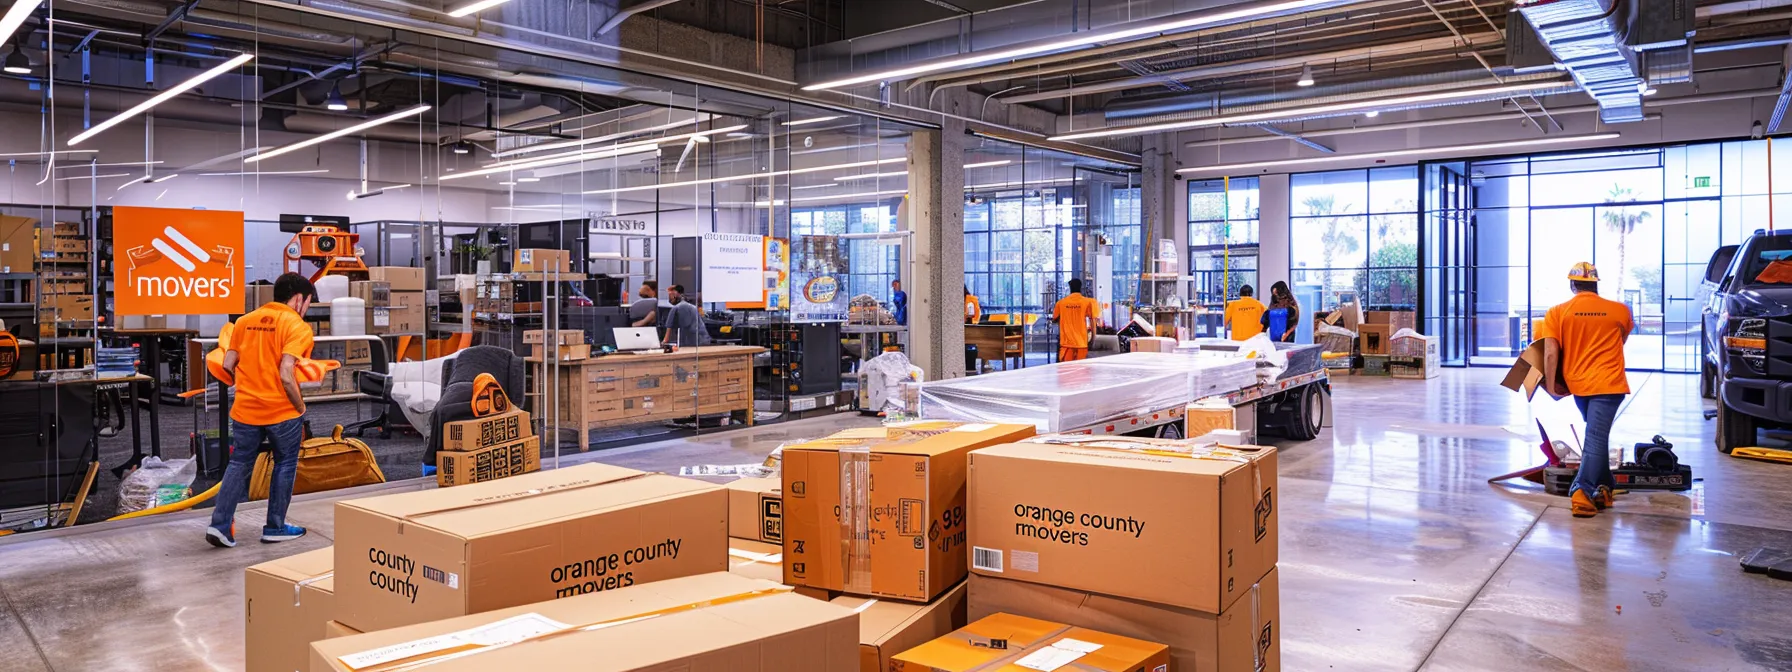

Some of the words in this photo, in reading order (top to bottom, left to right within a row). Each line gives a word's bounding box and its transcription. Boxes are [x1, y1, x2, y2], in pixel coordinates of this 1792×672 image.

[137, 276, 231, 298] movers
[1014, 503, 1075, 528] orange
[1080, 512, 1146, 538] county
[550, 553, 619, 583] orange
[624, 538, 682, 565] county
[369, 570, 419, 604] county
